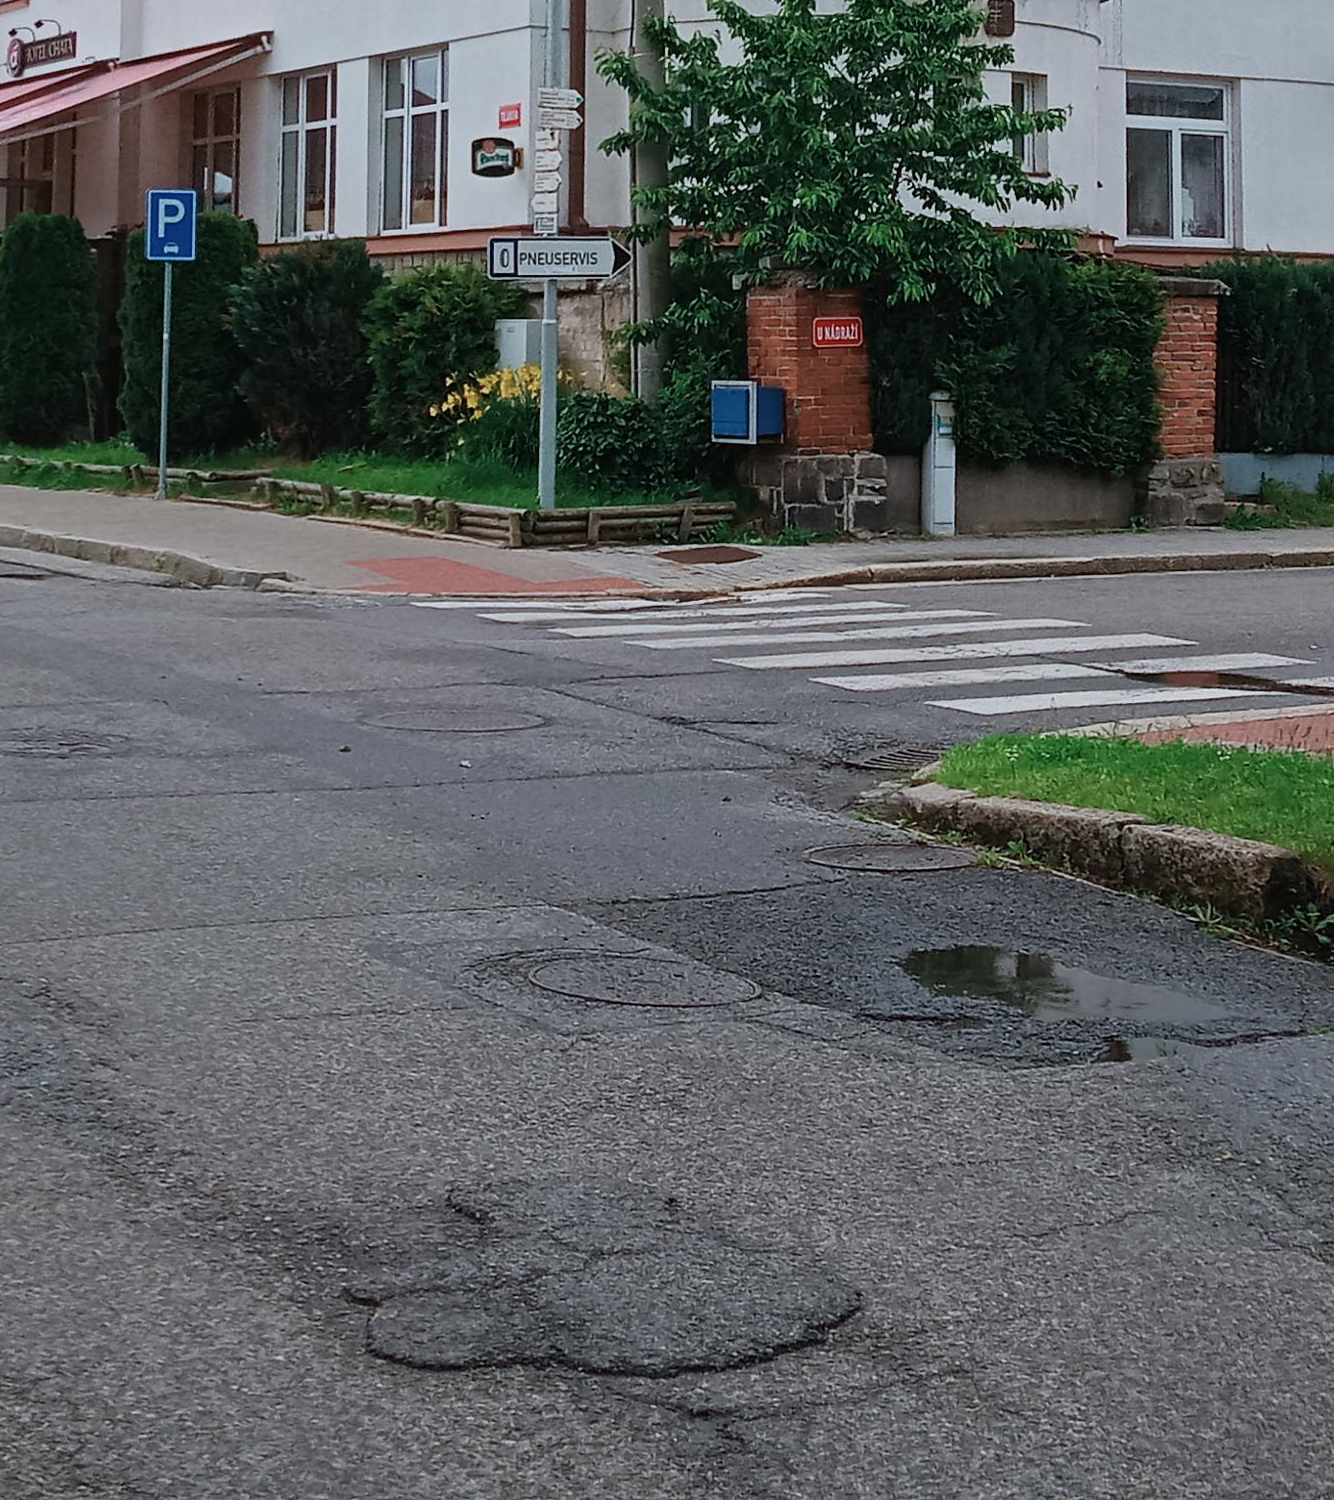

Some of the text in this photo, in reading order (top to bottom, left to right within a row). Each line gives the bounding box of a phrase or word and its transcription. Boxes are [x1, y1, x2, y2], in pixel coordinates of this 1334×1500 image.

[158, 198, 185, 238] P
[519, 252, 598, 266] PNEUSERVIS
[817, 324, 858, 340] U NÁDRAŽÍ
